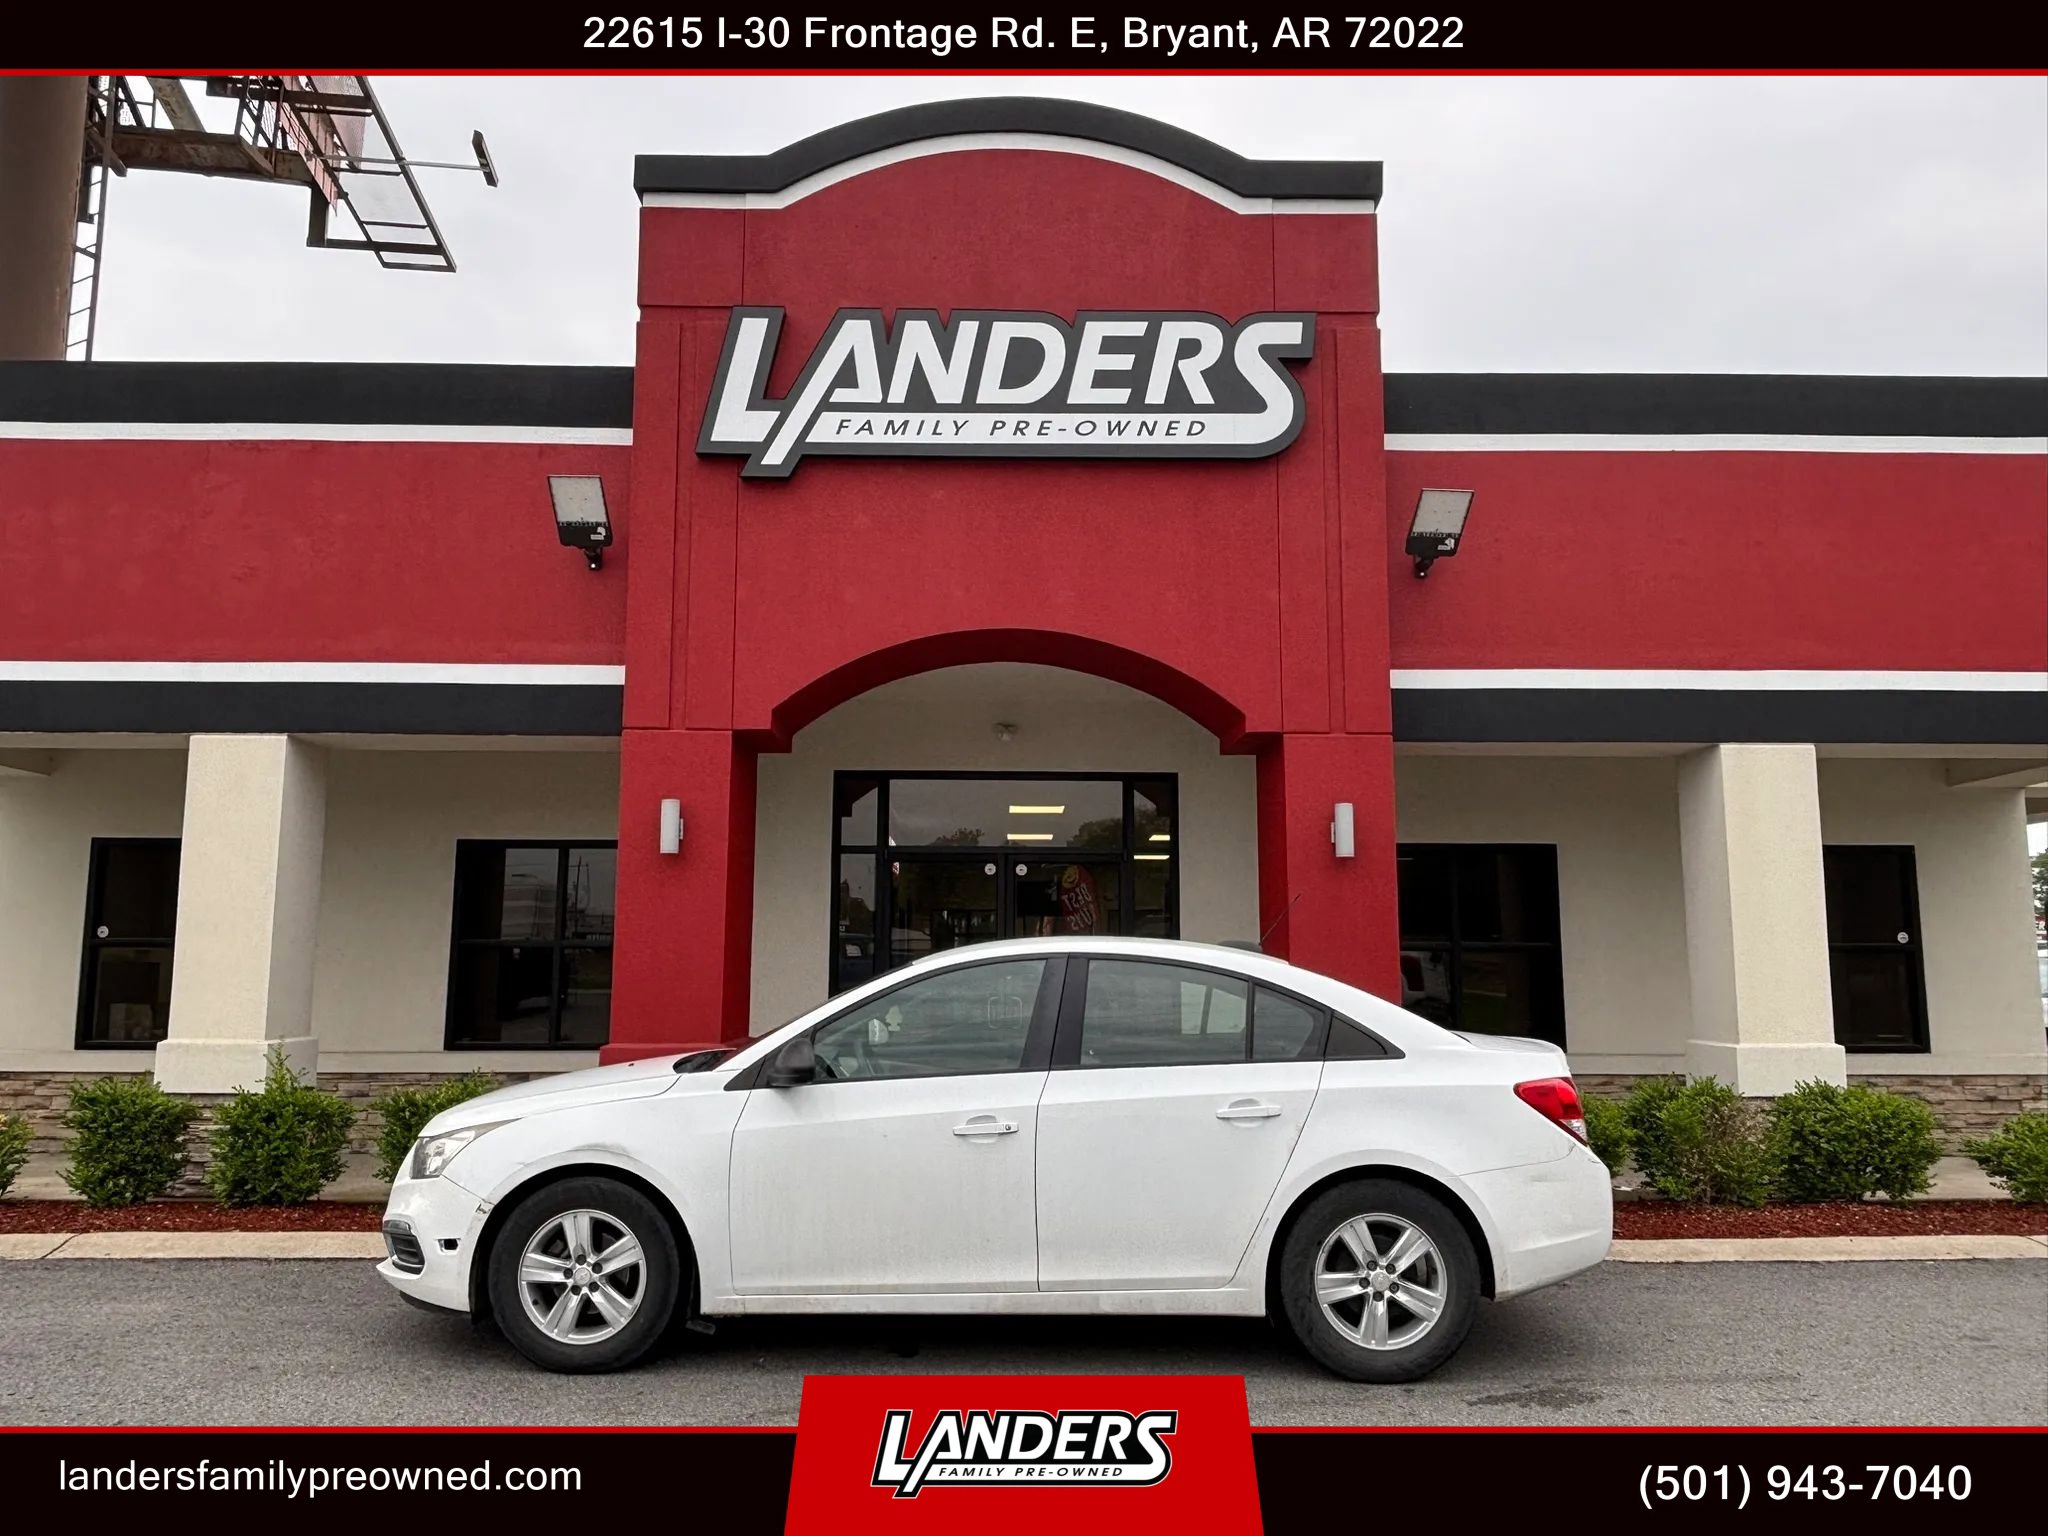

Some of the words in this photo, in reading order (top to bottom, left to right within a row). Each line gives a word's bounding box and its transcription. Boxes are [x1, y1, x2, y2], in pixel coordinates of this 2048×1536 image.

[711, 317, 1303, 465] LANDERS
[836, 419, 969, 437] FAMILY
[989, 419, 1207, 438] PRE-OWNED
